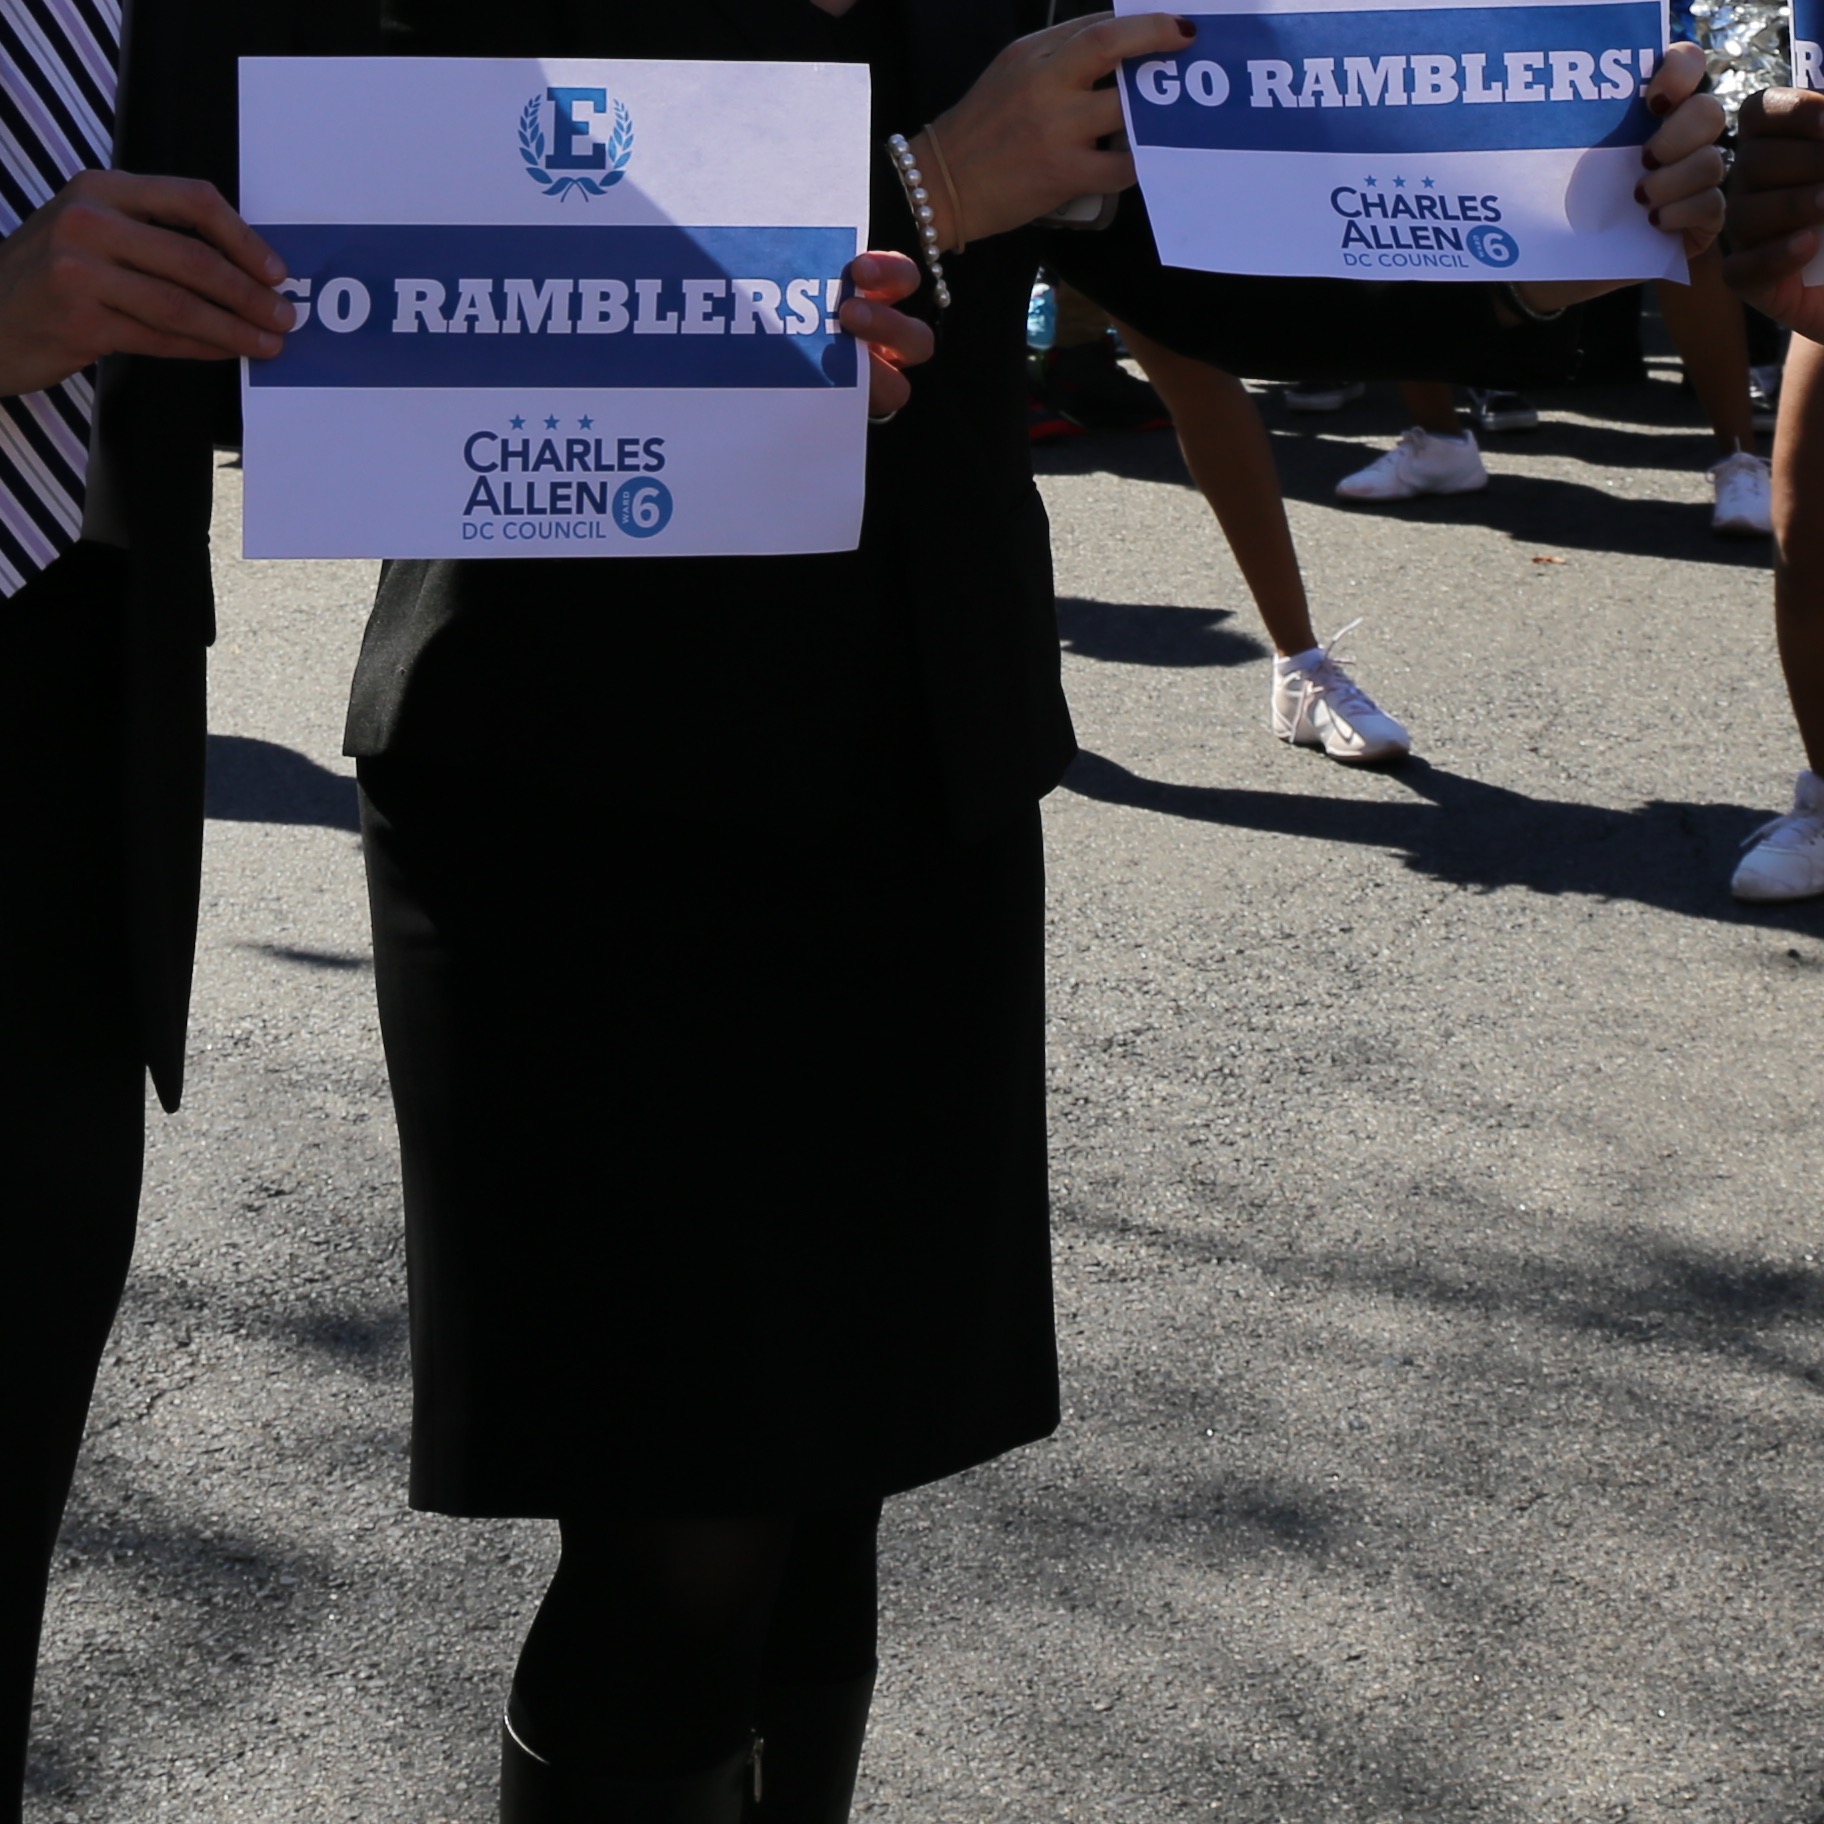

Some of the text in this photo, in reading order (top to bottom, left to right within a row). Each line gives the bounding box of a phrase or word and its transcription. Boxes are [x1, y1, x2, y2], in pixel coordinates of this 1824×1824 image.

[1135, 48, 1654, 109] GO RAMBLERS!
[546, 87, 607, 170] E
[1330, 186, 1502, 223] CHARLES
[1341, 219, 1464, 251] ALLEN
[1482, 232, 1510, 262] 6
[1343, 253, 1469, 268] DC COUNCIL
[393, 278, 843, 335] RAMBLERS!
[464, 430, 666, 473] CHARLES
[463, 475, 608, 516] ALLEN
[622, 487, 661, 529] WARD 6
[463, 521, 606, 540] DC COUNCIL
